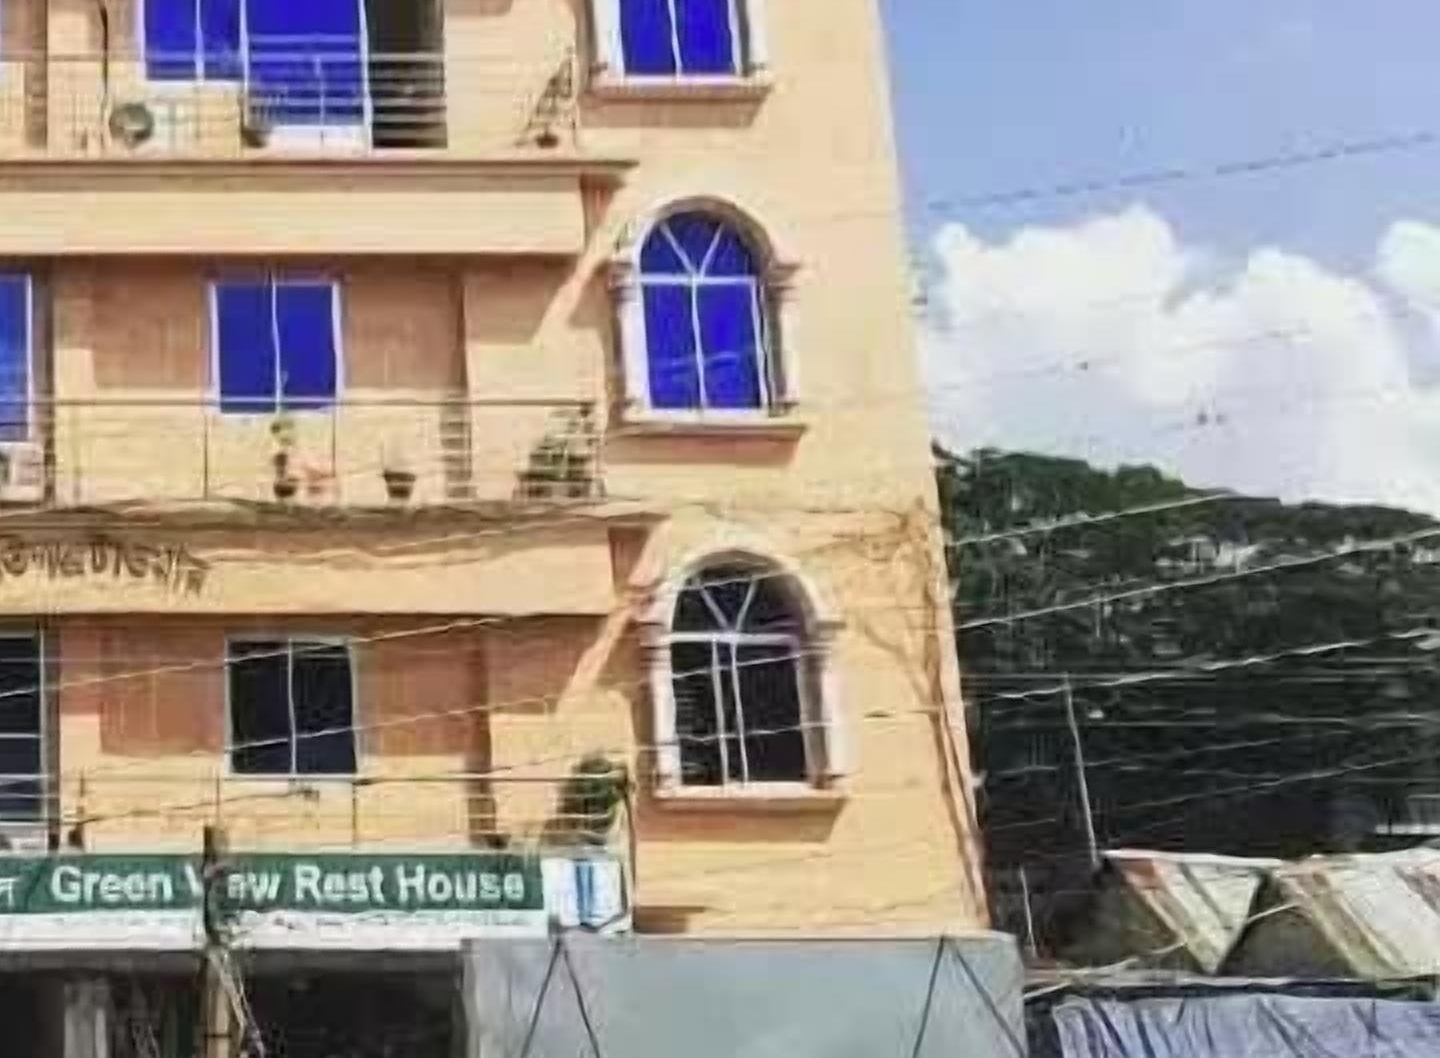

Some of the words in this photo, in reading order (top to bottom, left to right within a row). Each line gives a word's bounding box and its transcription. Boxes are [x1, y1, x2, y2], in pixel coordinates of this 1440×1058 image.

[50, 863, 173, 903] Green
[183, 863, 281, 903] Vew
[294, 863, 385, 902] Rest
[398, 863, 525, 902] House
